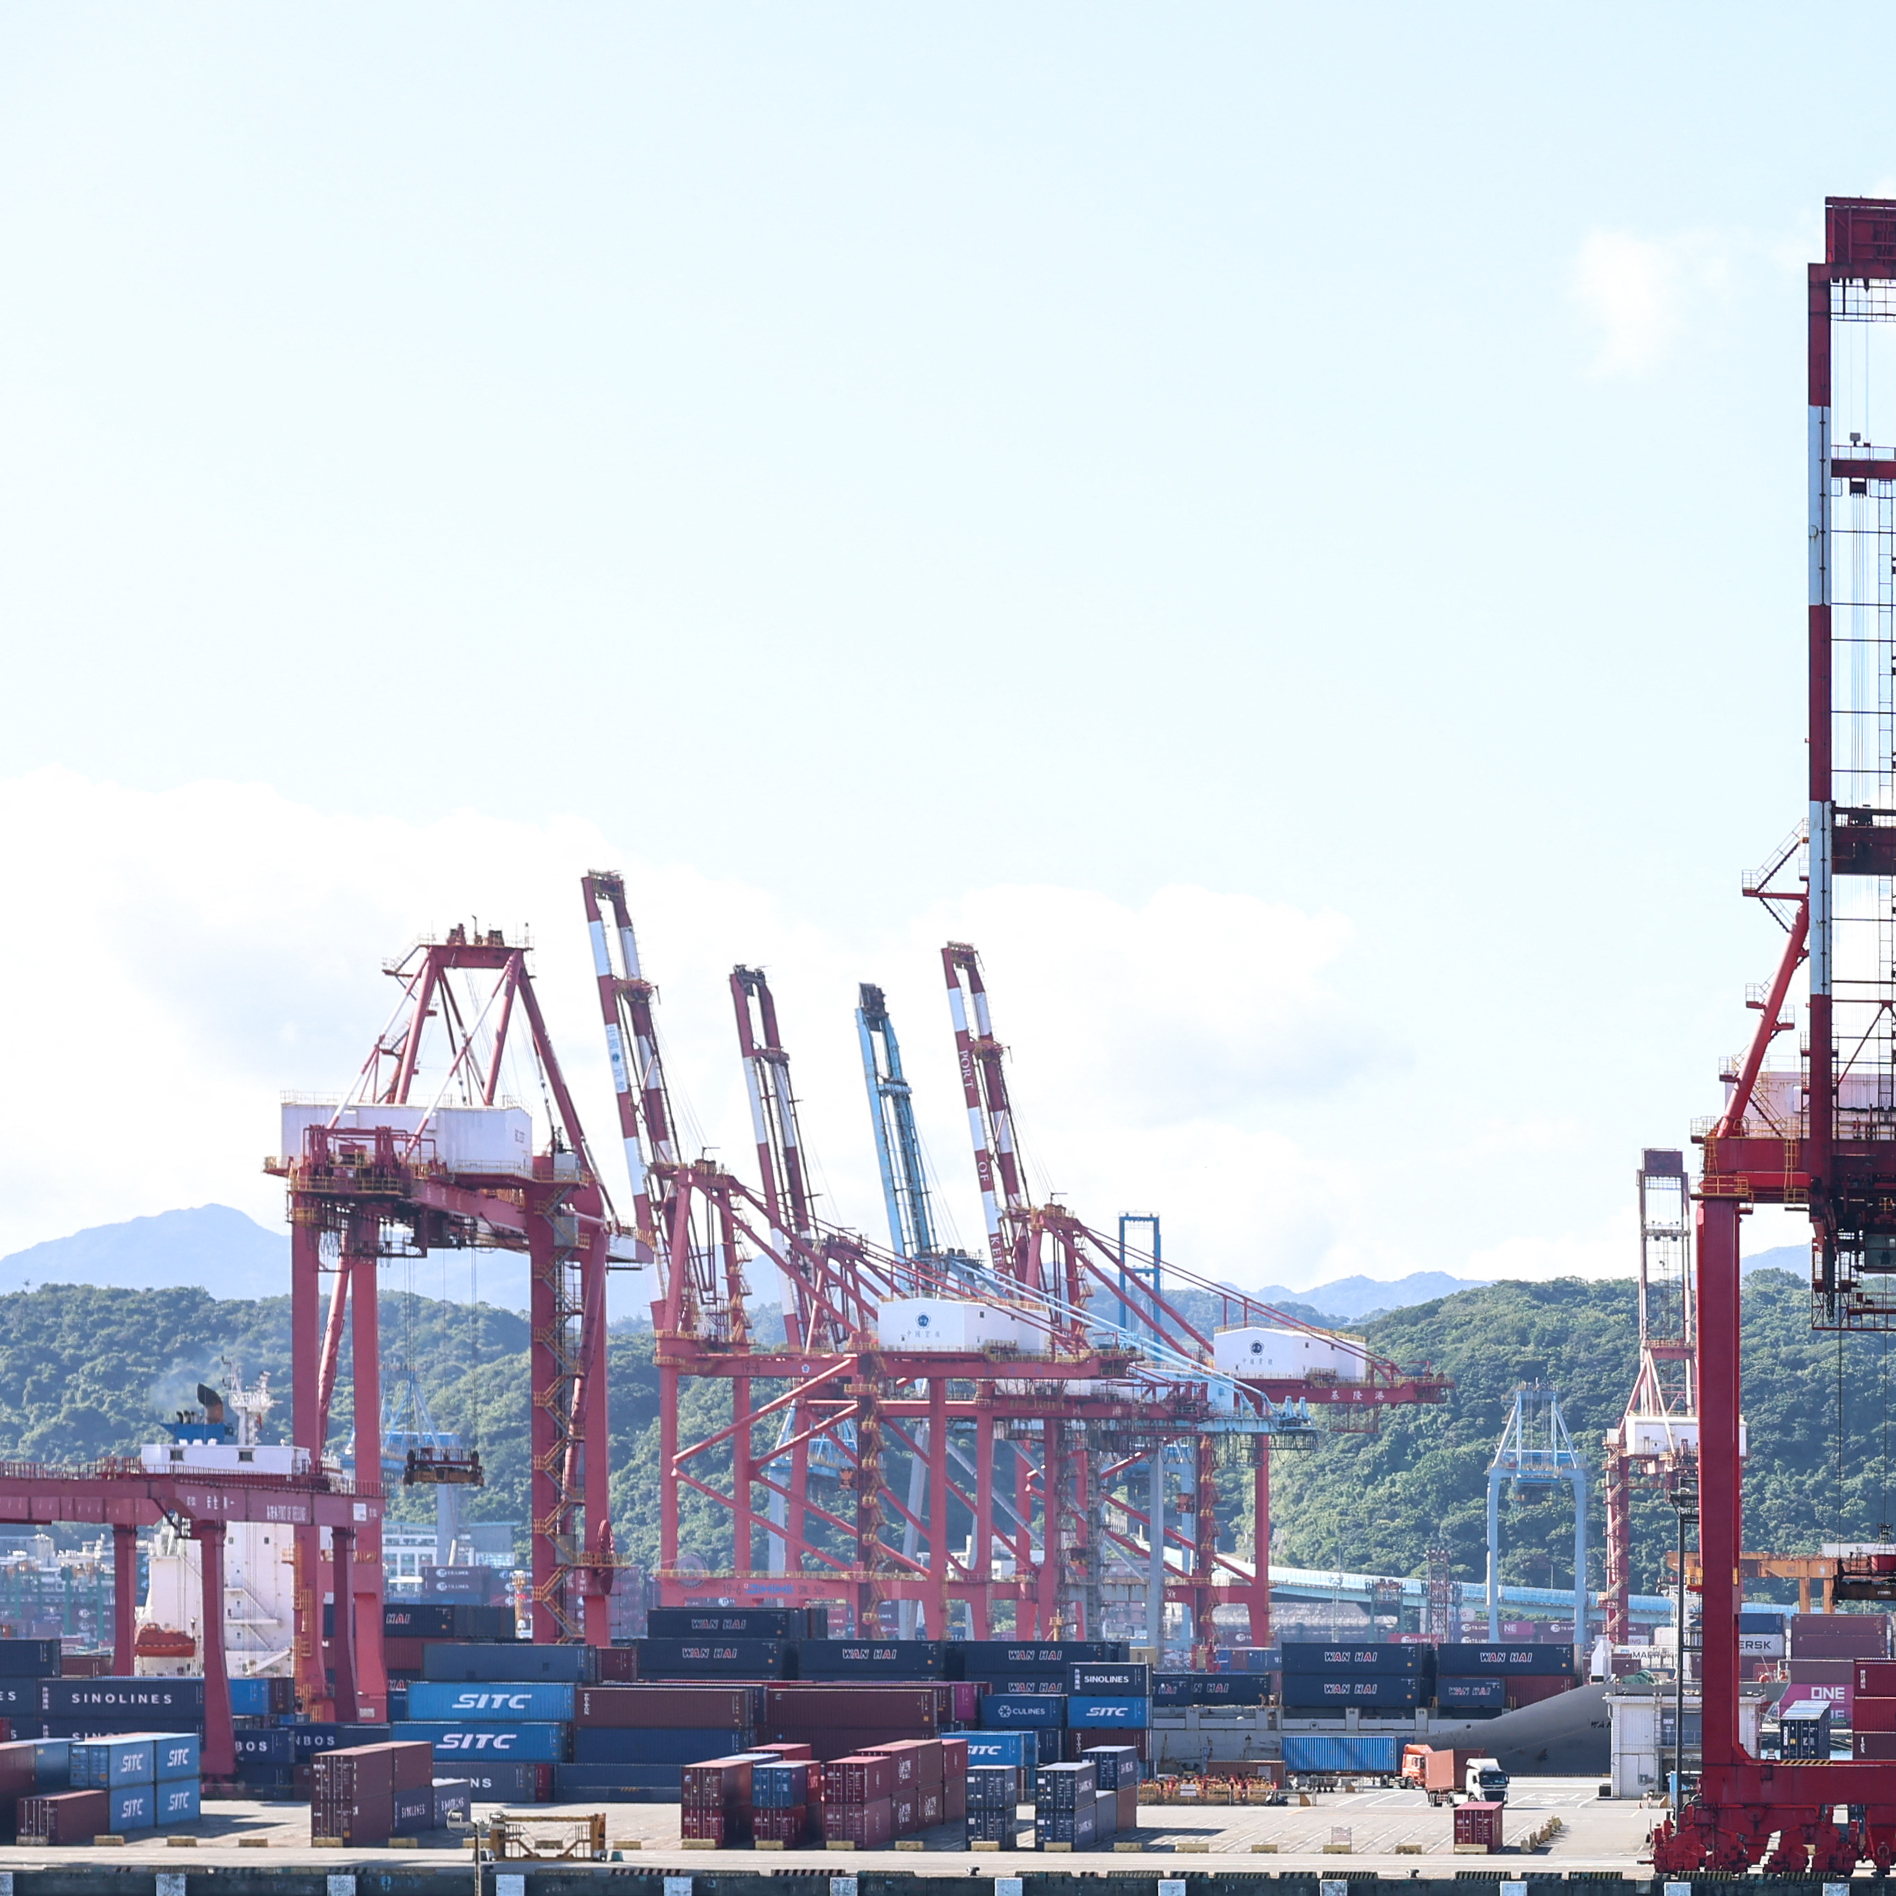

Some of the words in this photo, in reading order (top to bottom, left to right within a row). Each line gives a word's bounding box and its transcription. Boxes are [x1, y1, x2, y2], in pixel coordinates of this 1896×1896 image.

[959, 1050, 974, 1089] PORT
[977, 1161, 989, 1182] OF
[691, 1618, 717, 1629] WAN
[722, 1618, 747, 1629] HAI
[681, 1647, 709, 1659] WAN
[713, 1647, 737, 1659] HAI
[842, 1648, 869, 1660] WAN
[873, 1648, 897, 1660] HAI
[1008, 1650, 1034, 1661] WAN
[1038, 1650, 1062, 1661] HAI
[1324, 1651, 1351, 1662] WAN
[1354, 1651, 1378, 1662] HAI
[1480, 1652, 1506, 1663] WAN
[1510, 1652, 1533, 1663] HAI
[1084, 1675, 1129, 1685] SINOLINES
[1008, 1682, 1034, 1693] WAN
[1038, 1682, 1062, 1693] HAI
[1323, 1684, 1350, 1695] WAN
[1354, 1684, 1378, 1695] HAI
[1810, 1686, 1845, 1700] ONE
[72, 1692, 173, 1705] SINOLINES
[451, 1693, 532, 1709] SITC
[1012, 1707, 1046, 1716] CULINES
[1085, 1706, 1129, 1718] SITC
[435, 1733, 517, 1749] SITC
[120, 1753, 143, 1773] SITC
[166, 1748, 190, 1768] SITC
[168, 1791, 190, 1811] SITC
[121, 1798, 143, 1818] SITC
